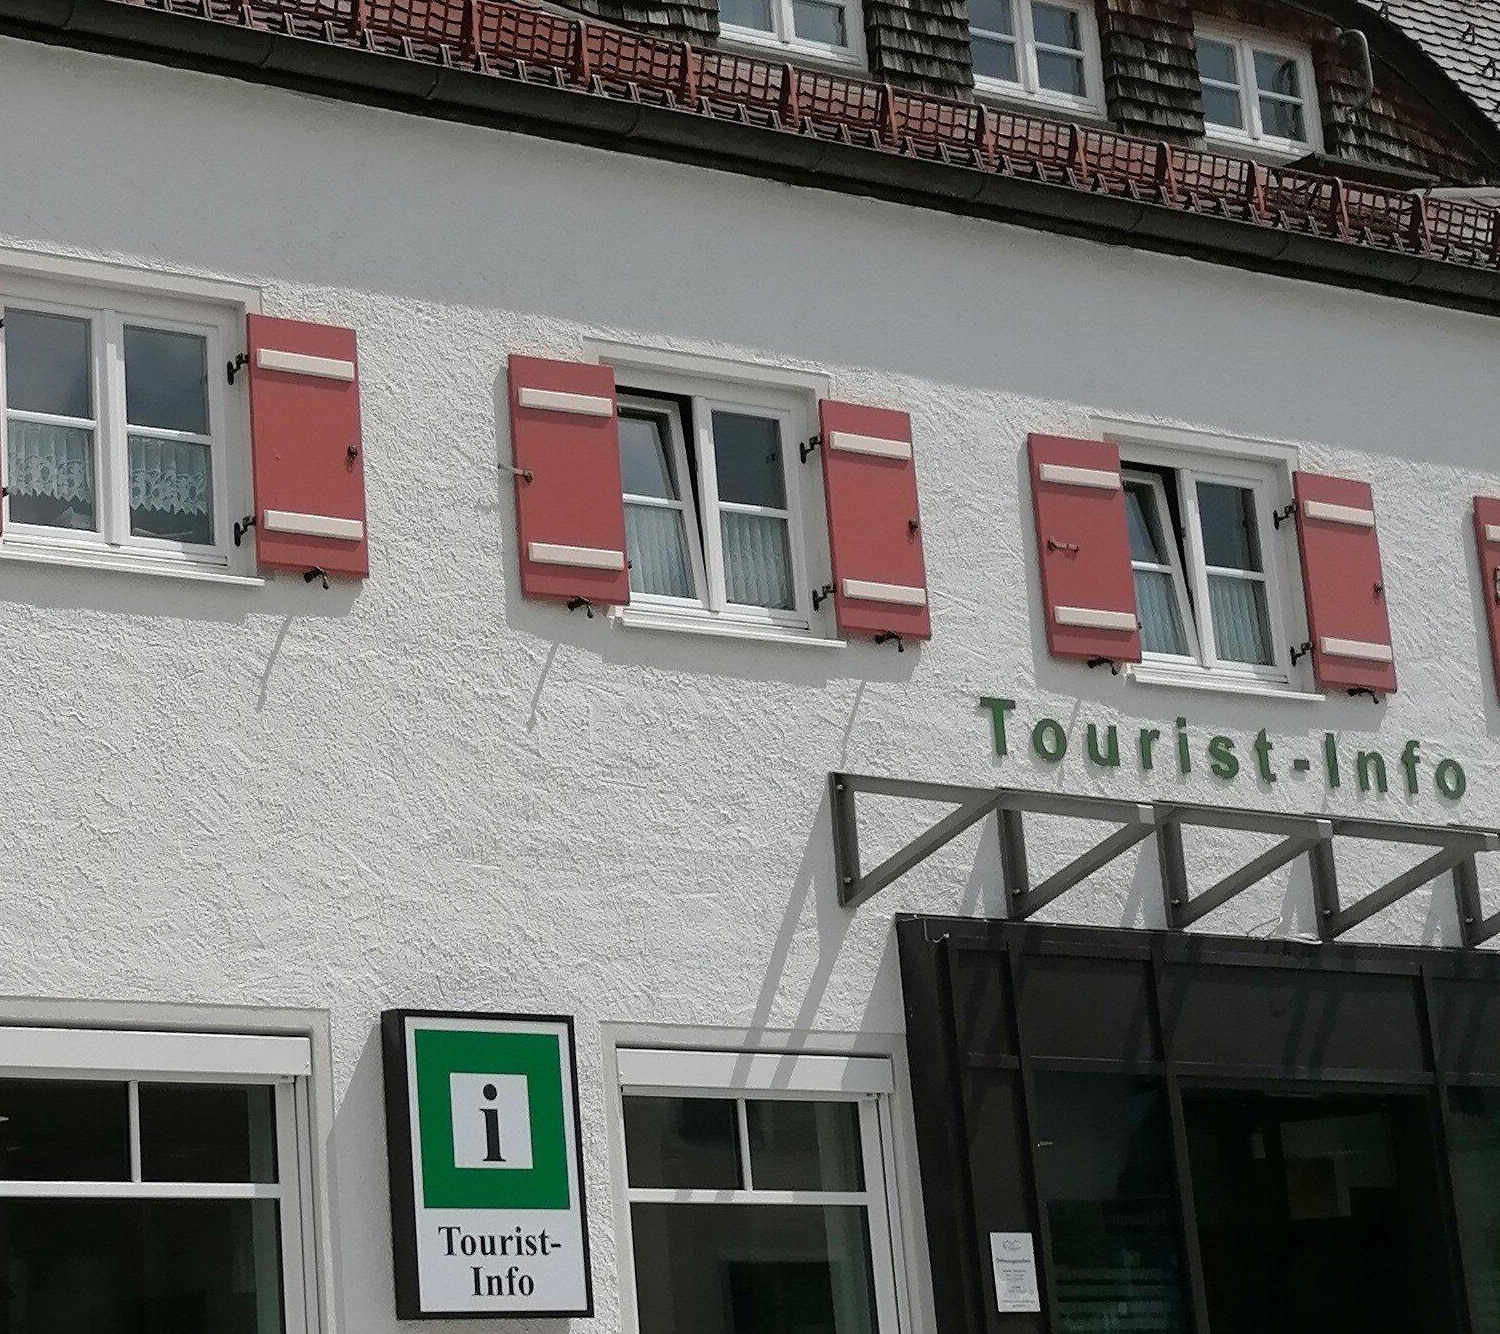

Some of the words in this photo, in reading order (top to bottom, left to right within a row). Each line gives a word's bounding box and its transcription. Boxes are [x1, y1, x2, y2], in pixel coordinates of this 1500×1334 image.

[979, 696, 1467, 799] Tourist-Info
[479, 1083, 507, 1162] i
[438, 1225, 562, 1257] Tourist-
[470, 1265, 535, 1297] Info
